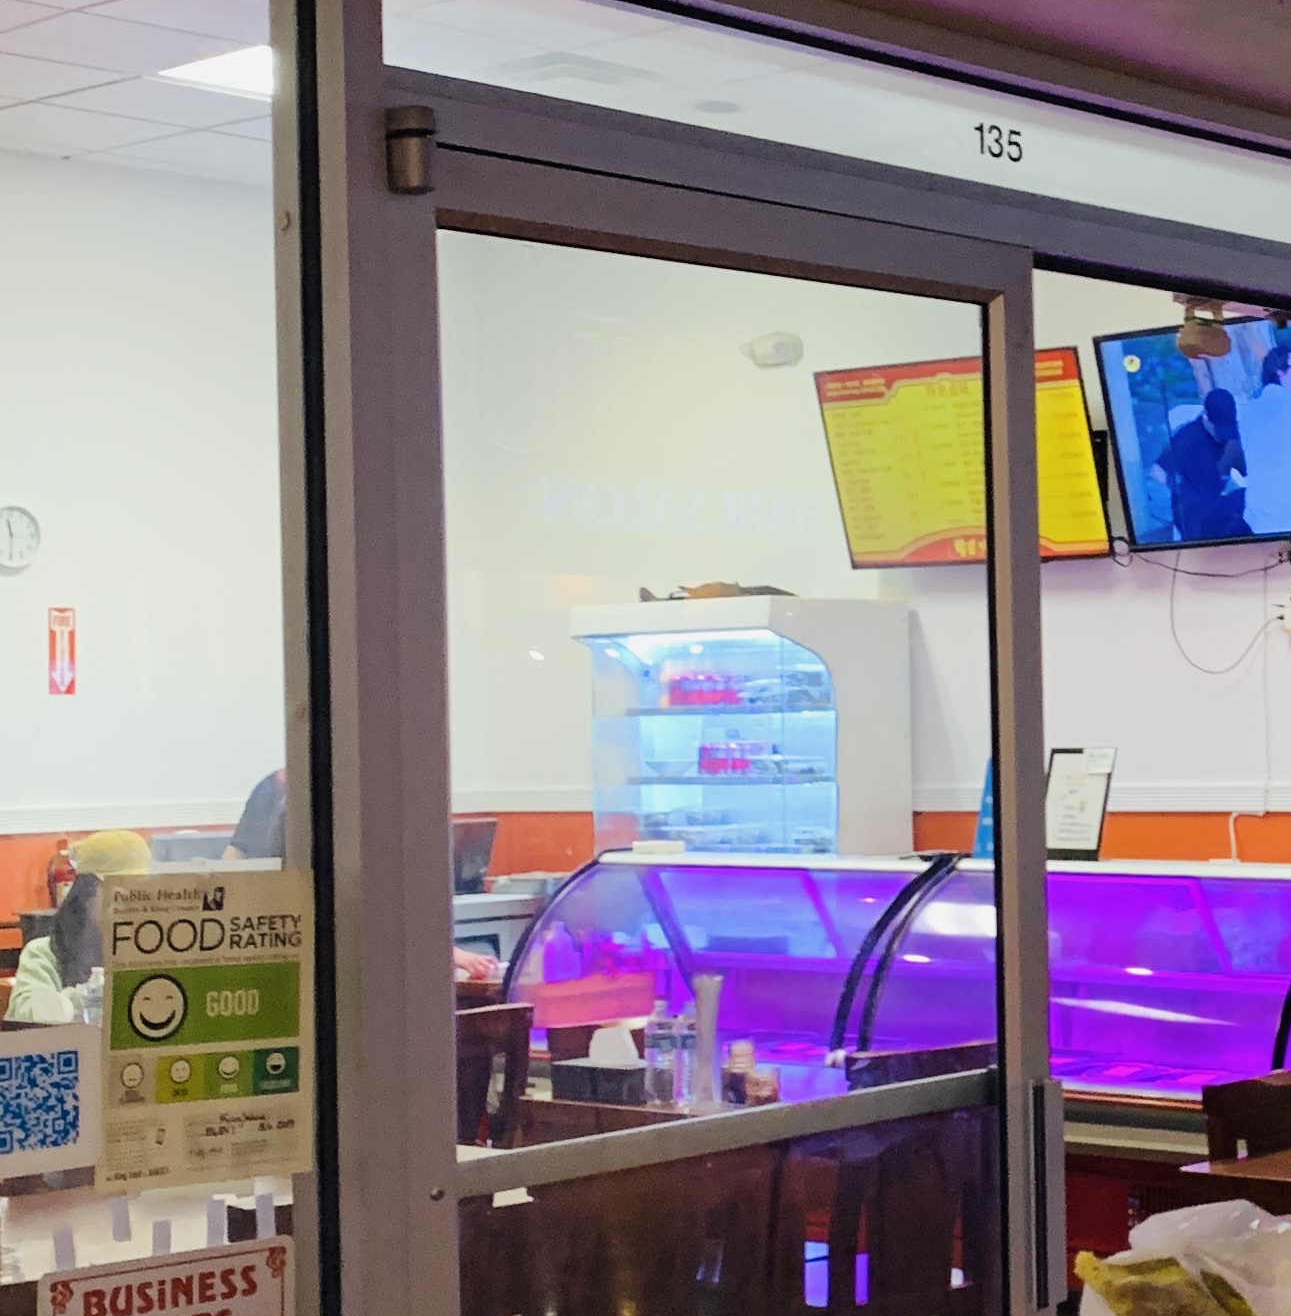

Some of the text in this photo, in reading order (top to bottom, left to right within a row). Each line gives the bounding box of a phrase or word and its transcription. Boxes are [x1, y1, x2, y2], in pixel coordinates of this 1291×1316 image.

[974, 123, 1022, 163] 135
[113, 887, 201, 903] Public Health
[229, 913, 301, 933] SAFETY
[111, 918, 226, 956] FOOD
[229, 931, 301, 950] RATING
[206, 988, 260, 1018] GOOD
